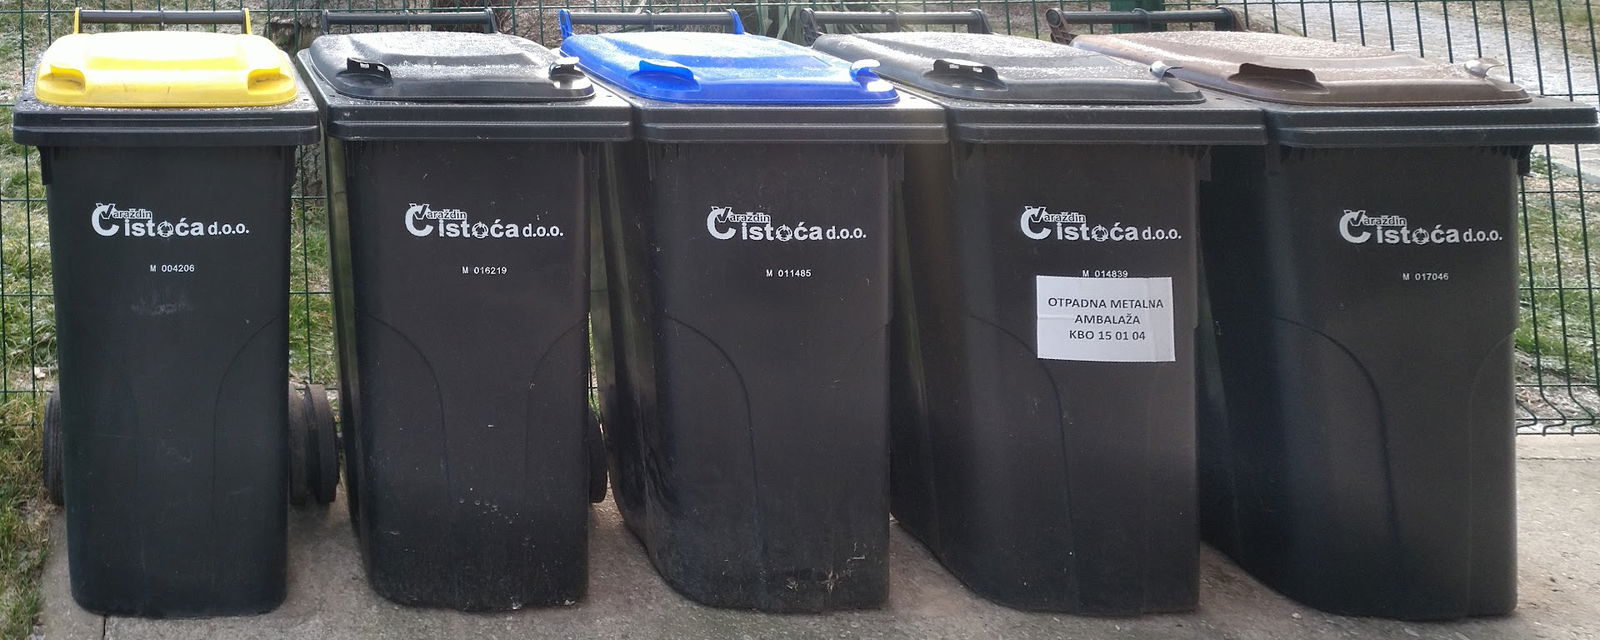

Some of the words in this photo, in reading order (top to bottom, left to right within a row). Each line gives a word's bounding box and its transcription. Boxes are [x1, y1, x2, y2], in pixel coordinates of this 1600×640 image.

[207, 221, 250, 236] d.o.o.
[522, 223, 564, 237] d.o.o.
[826, 225, 867, 240] d.o.o.
[1141, 226, 1182, 240] d.o.o.
[1463, 228, 1503, 242] d.o.o.
[150, 264, 157, 272] M
[161, 264, 195, 272] 004206
[462, 266, 469, 274] M
[473, 266, 507, 275] 016219
[766, 269, 773, 277] M
[778, 269, 812, 277] 011485
[1094, 270, 1129, 278] 014839
[1415, 273, 1449, 281] 017046
[1048, 297, 1107, 309] OTPADNA
[1110, 299, 1163, 309] METALNA
[1074, 313, 1141, 325] AMBALAŽA
[1069, 330, 1095, 340] KBO
[1098, 331, 1112, 340] 15
[1115, 331, 1129, 340] 01
[1132, 331, 1146, 341] 04
